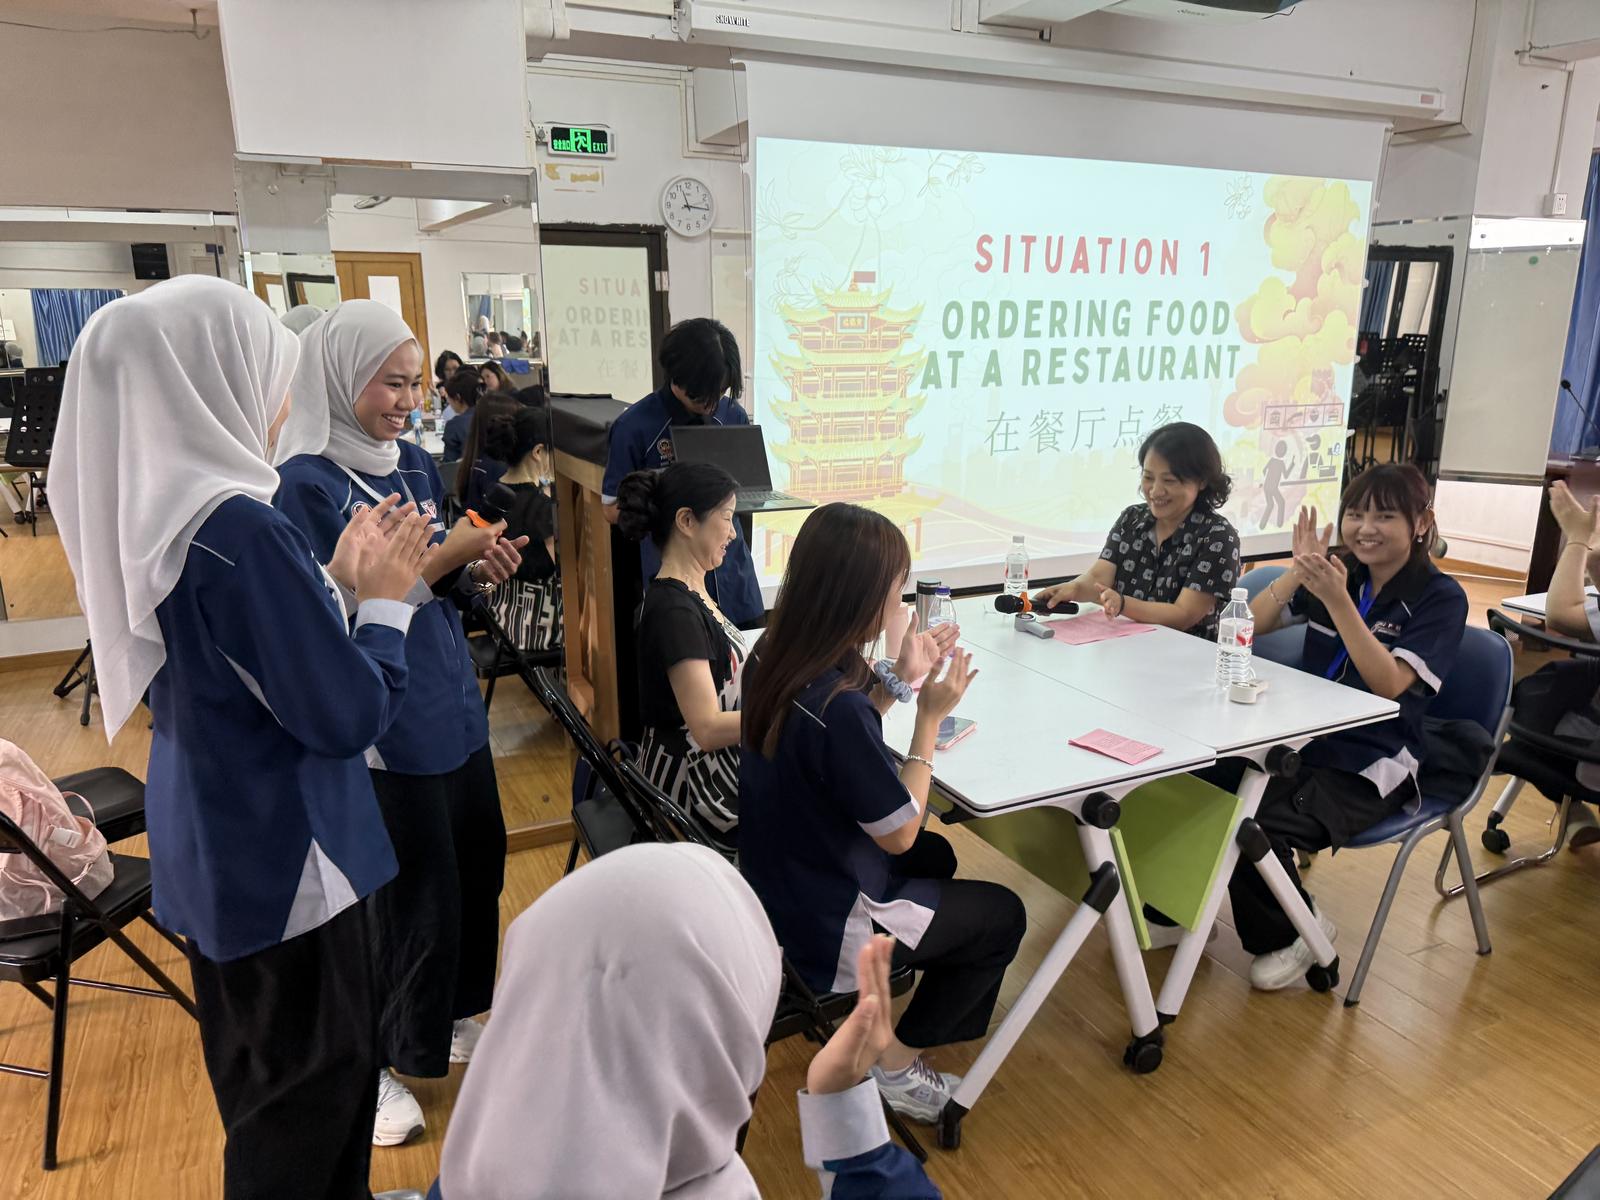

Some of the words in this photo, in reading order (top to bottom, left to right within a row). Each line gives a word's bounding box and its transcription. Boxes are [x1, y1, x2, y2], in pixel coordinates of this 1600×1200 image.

[593, 142, 608, 152] EXIT
[974, 234, 1179, 275] SITUATION
[1199, 242, 1211, 277] 1
[558, 327, 580, 347] AT
[590, 328, 602, 347] A
[942, 300, 1131, 339] ORDERING
[1146, 300, 1230, 337] FOOD
[919, 350, 965, 390] AT
[980, 349, 1003, 387] A
[1021, 345, 1241, 386] RESTAURANT
